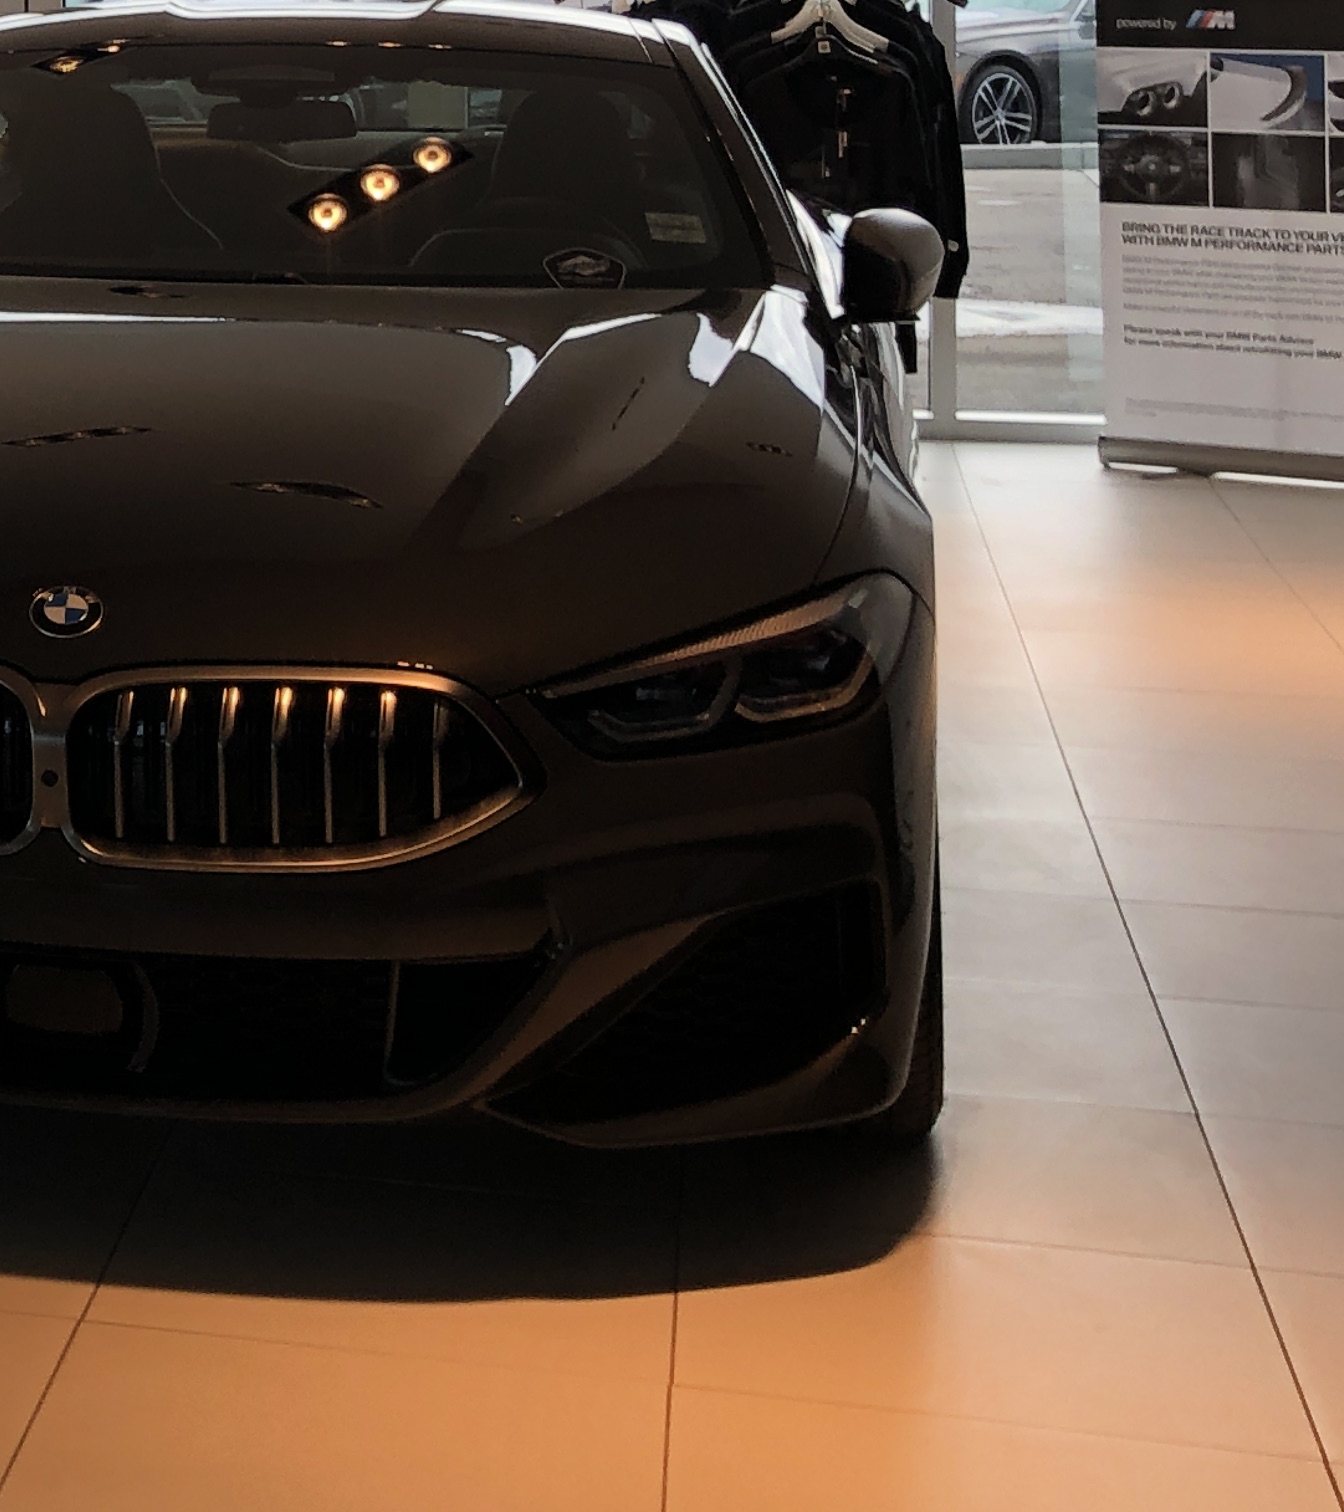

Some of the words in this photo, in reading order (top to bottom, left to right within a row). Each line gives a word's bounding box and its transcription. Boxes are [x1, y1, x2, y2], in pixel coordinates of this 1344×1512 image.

[1121, 221, 1161, 235] BRING
[1162, 223, 1188, 236] THE
[1190, 224, 1225, 238] RACE
[1228, 226, 1271, 239] TRACK
[1273, 228, 1292, 240] TO
[1292, 229, 1329, 243] YOUR
[1121, 233, 1155, 246] WITH
[1156, 235, 1189, 248] BMW
[1190, 237, 1203, 248] M
[1205, 238, 1304, 254] PERFORMANCE
